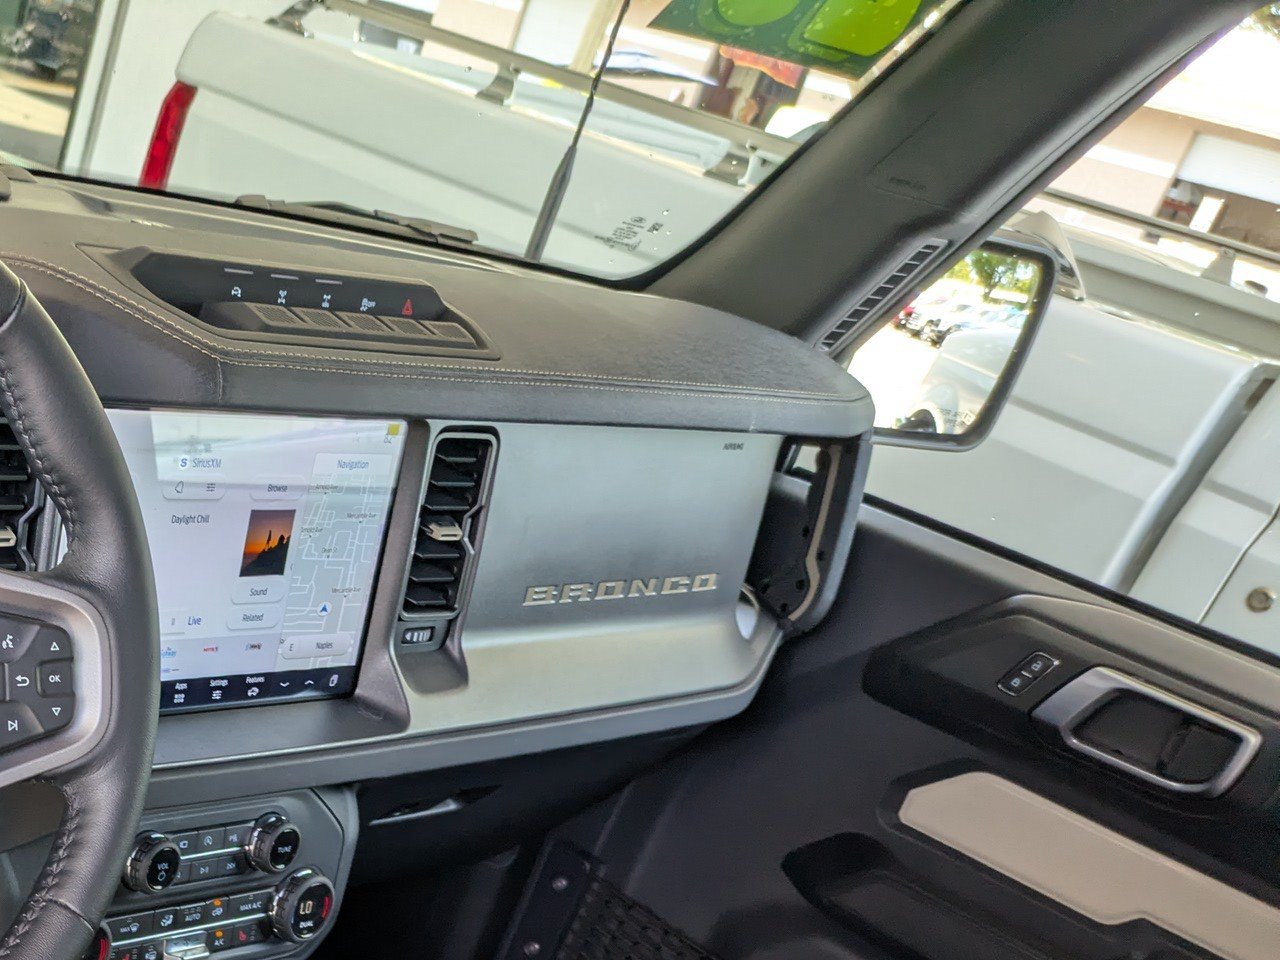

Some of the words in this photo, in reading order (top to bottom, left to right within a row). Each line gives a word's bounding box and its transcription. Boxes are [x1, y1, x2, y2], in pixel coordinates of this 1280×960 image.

[192, 457, 222, 469] SiriusXM
[336, 459, 370, 471] Navigation
[267, 483, 288, 493] Browse
[171, 514, 196, 525] Daylight
[196, 514, 210, 524] Chill
[249, 587, 268, 598] Sound
[522, 572, 719, 607] BRONCO
[187, 616, 202, 626] Live
[242, 612, 264, 623] Related
[315, 641, 334, 651] Naples
[48, 674, 62, 683] OK
[210, 679, 229, 688] Settings
[245, 676, 266, 684] Features
[174, 682, 188, 690] Apps
[157, 862, 169, 870] VOL
[299, 900, 313, 915] LO
[185, 913, 201, 922] AUTO
